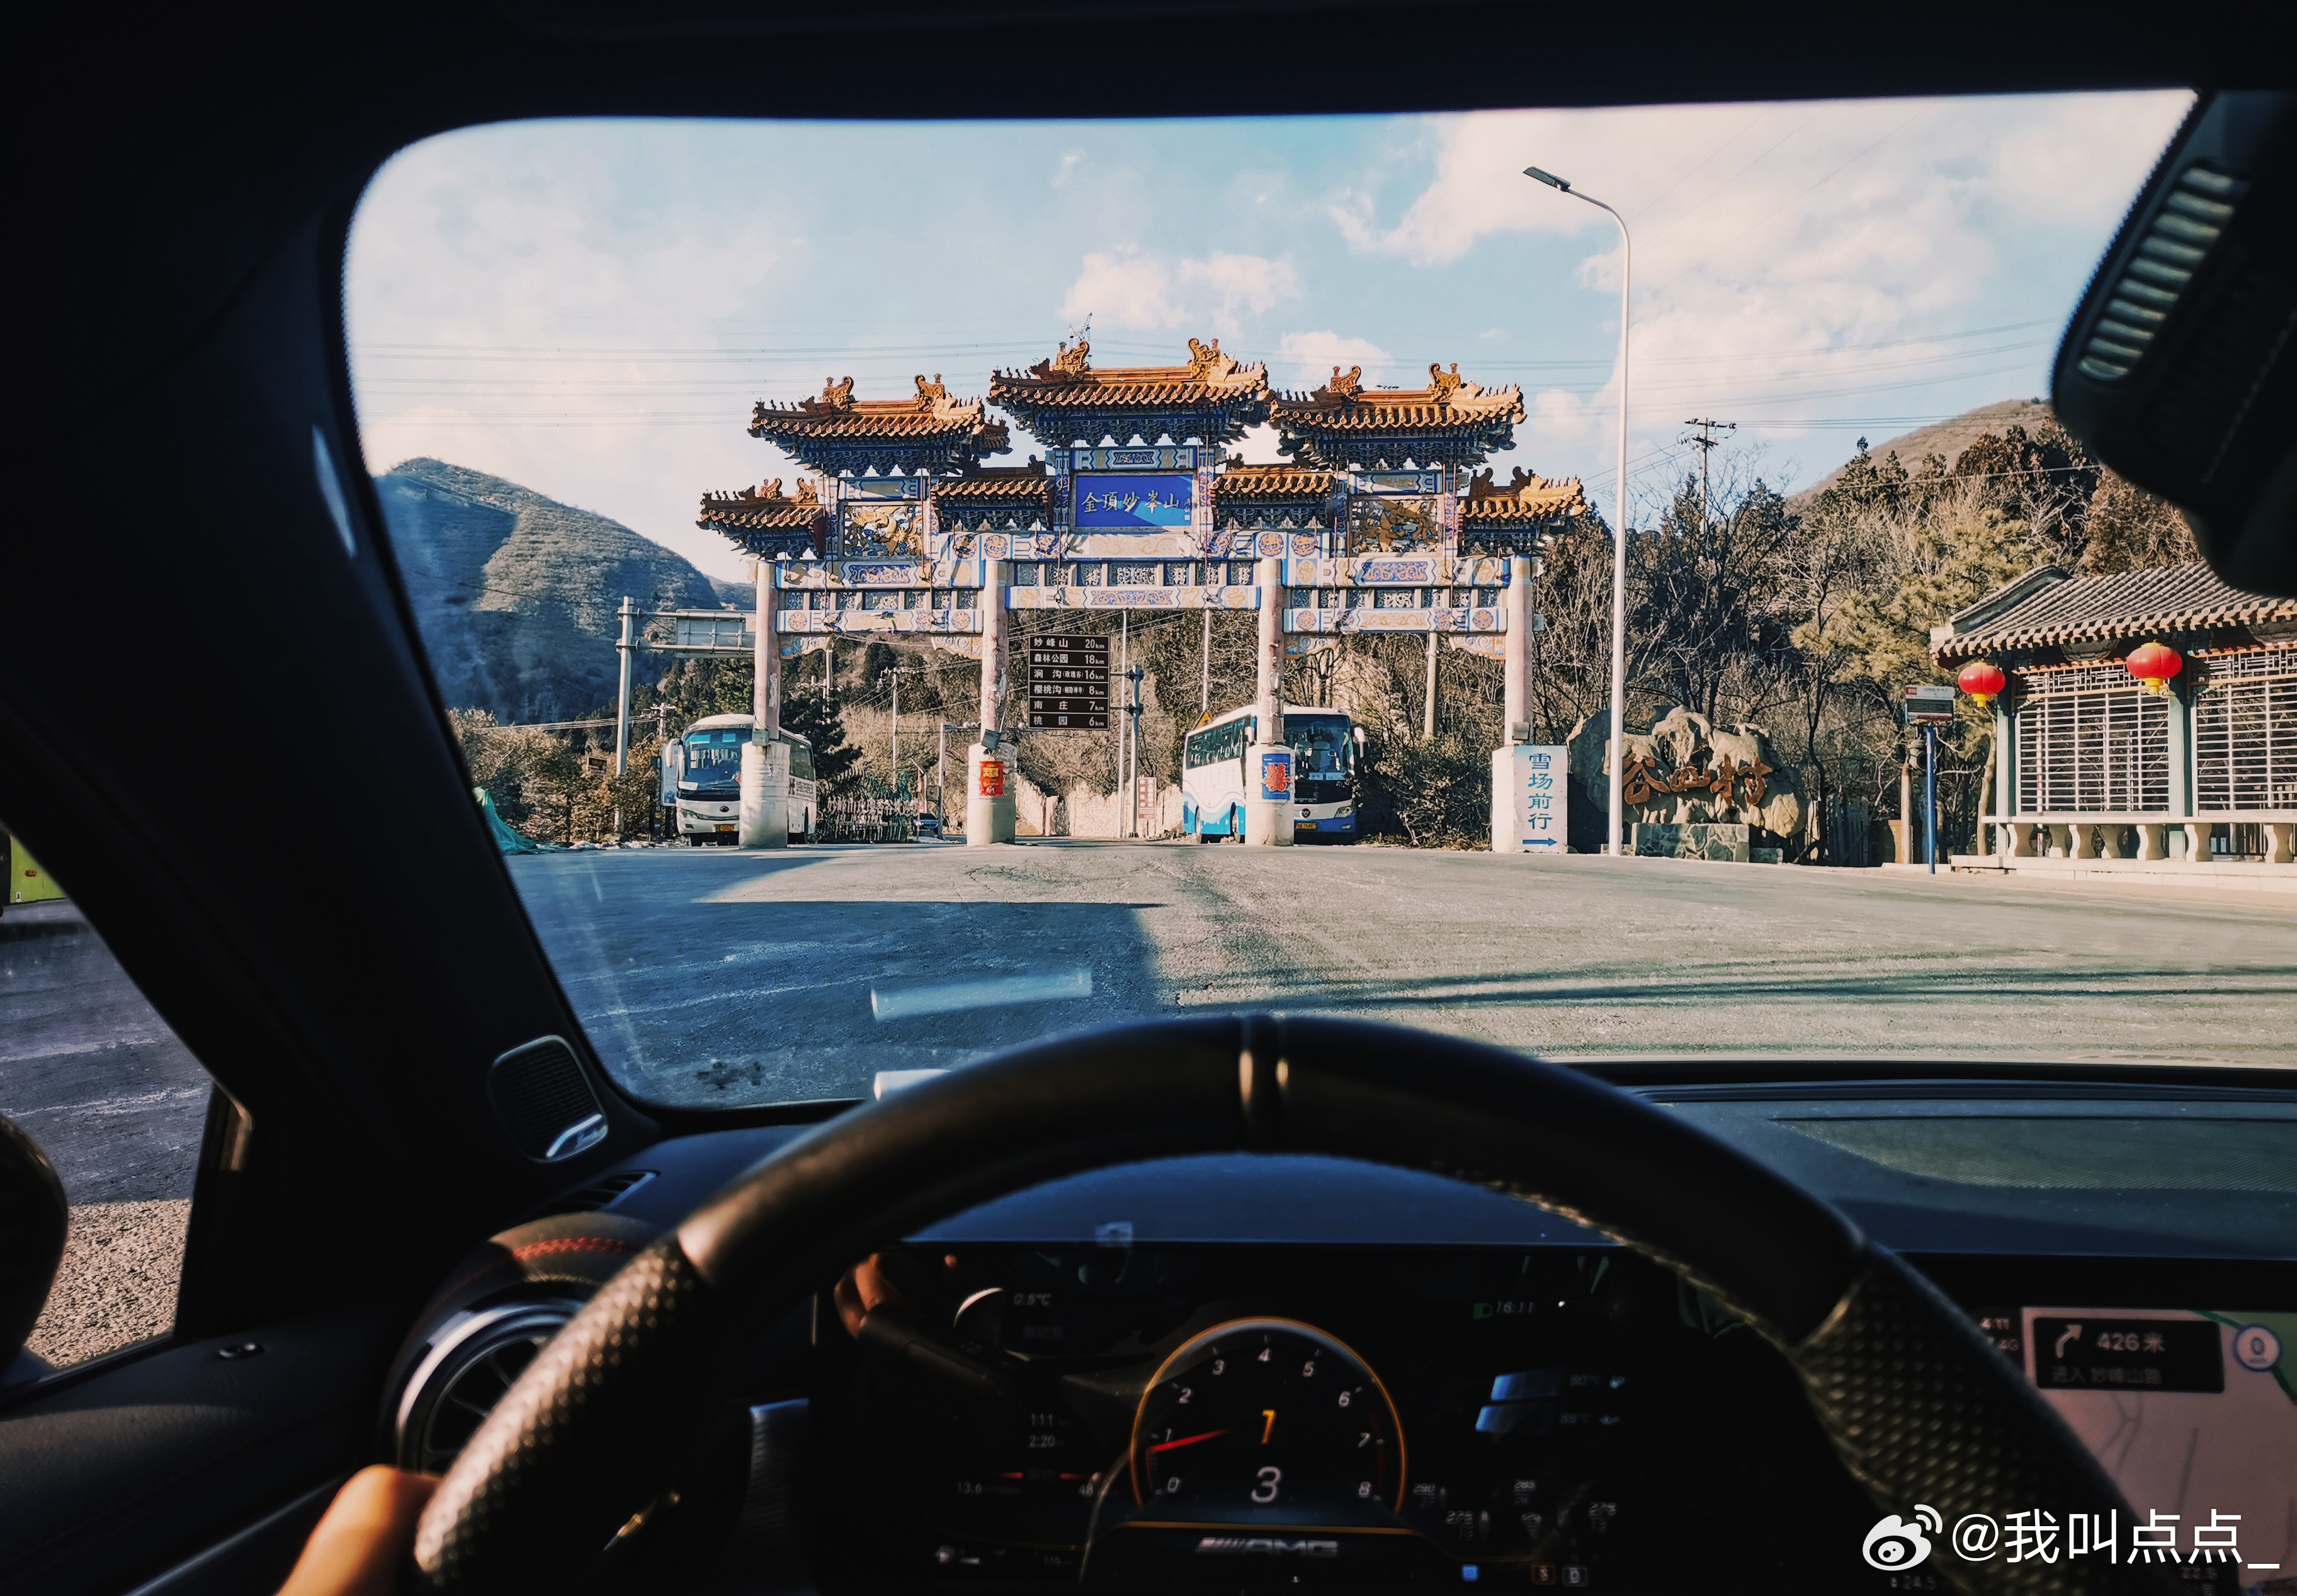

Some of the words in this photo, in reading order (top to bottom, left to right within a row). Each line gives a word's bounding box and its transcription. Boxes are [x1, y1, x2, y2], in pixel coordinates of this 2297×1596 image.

[1033, 638, 1069, 648] 妙峰山
[1085, 638, 1105, 650] 20km
[1033, 654, 1069, 664] 森林公园
[1085, 654, 1104, 665] 18km
[1085, 670, 1104, 681] 16km
[1089, 686, 1104, 696] 8km
[1089, 701, 1104, 711] 7km
[1089, 716, 1104, 727] 6km
[1528, 753, 1553, 830] 雪场前行
[1496, 1301, 1534, 1314] 16:11
[2096, 1332, 2140, 1352] 426
[2142, 1332, 2166, 1354] 米
[2250, 1337, 2266, 1355] 0
[1257, 1347, 1272, 1362] 4
[1211, 1359, 1225, 1376] 3
[1302, 1361, 1317, 1378] 5
[1178, 1387, 1193, 1405] 2
[1338, 1391, 1353, 1408] 6
[1030, 1412, 1053, 1427] 111
[1261, 1409, 1277, 1445] 1
[1028, 1434, 1055, 1449] 2:20
[1164, 1428, 1173, 1444] 1
[1358, 1433, 1371, 1449] 7
[1166, 1476, 1181, 1493] 0
[1251, 1466, 1282, 1504] 3
[1358, 1481, 1373, 1499] 8
